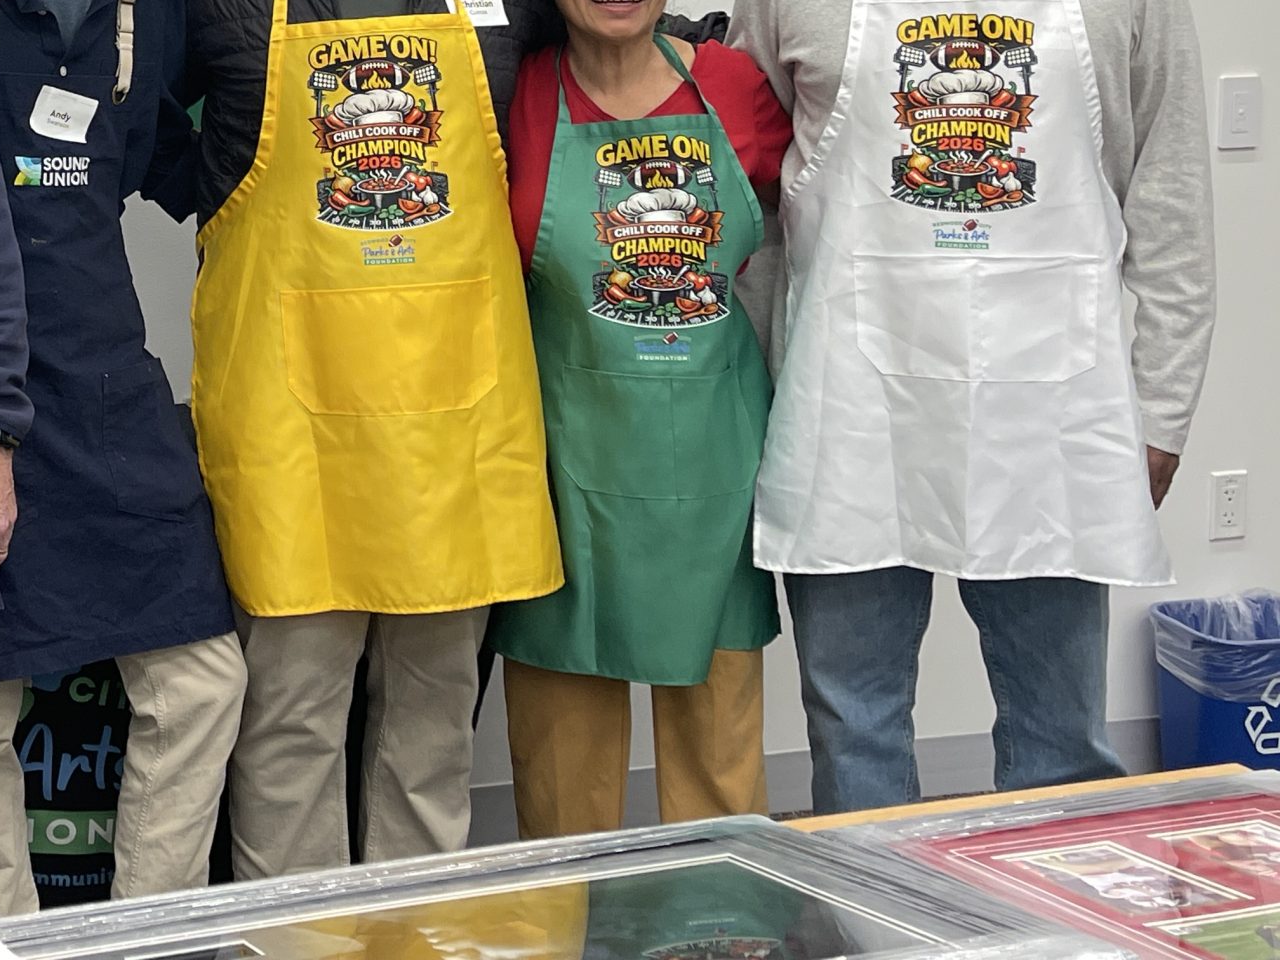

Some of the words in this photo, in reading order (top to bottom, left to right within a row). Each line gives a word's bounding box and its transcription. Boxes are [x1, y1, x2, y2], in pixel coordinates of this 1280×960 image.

[463, 0, 494, 8] hristian
[898, 14, 978, 45] GAME
[981, 14, 1034, 45] ON!
[309, 35, 387, 70] GAME
[390, 35, 437, 63] ON!
[50, 110, 72, 123] Andy
[914, 108, 947, 120] CHILI
[949, 107, 981, 118] COOK
[984, 108, 1009, 120] OFF
[333, 128, 363, 142] CHILI
[365, 126, 397, 137] COOK
[399, 126, 420, 137] OFF
[912, 121, 1011, 145] CHAMPION
[595, 135, 669, 167] GAME
[672, 135, 711, 166] ON!
[938, 137, 985, 151] 2026
[332, 140, 426, 167] CHAMPION
[43, 157, 91, 171] SOUND
[358, 156, 402, 170] 2026
[42, 172, 89, 186] UNION
[614, 225, 644, 238] CHILI
[647, 225, 679, 234] COOK
[681, 225, 704, 236] OFF
[612, 237, 706, 260] CHAMPION
[637, 253, 683, 267] 2026
